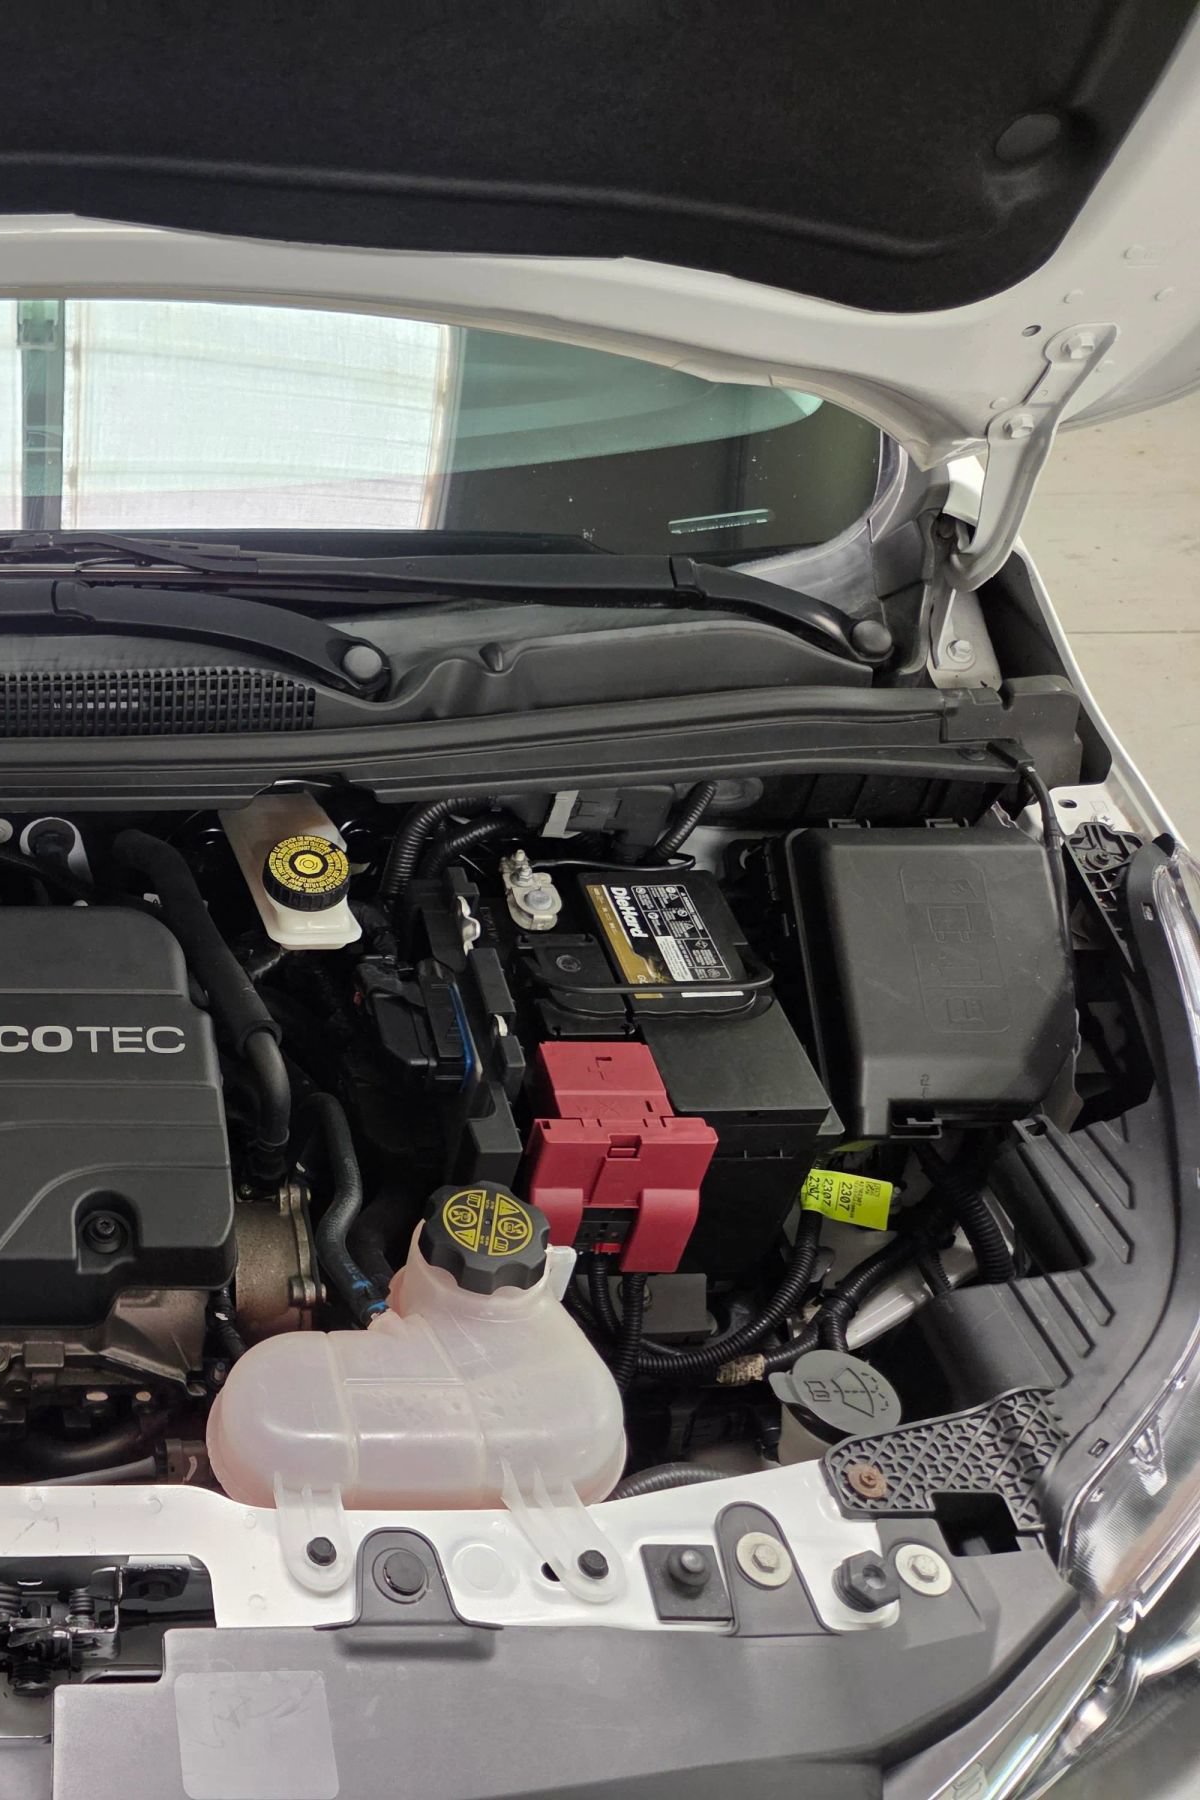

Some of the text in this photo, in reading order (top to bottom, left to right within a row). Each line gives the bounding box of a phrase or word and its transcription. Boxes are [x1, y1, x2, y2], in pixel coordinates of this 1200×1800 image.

[610, 887, 649, 938] DieHard
[823, 1177, 834, 1208] 2307
[839, 1181, 853, 1212] 2307
